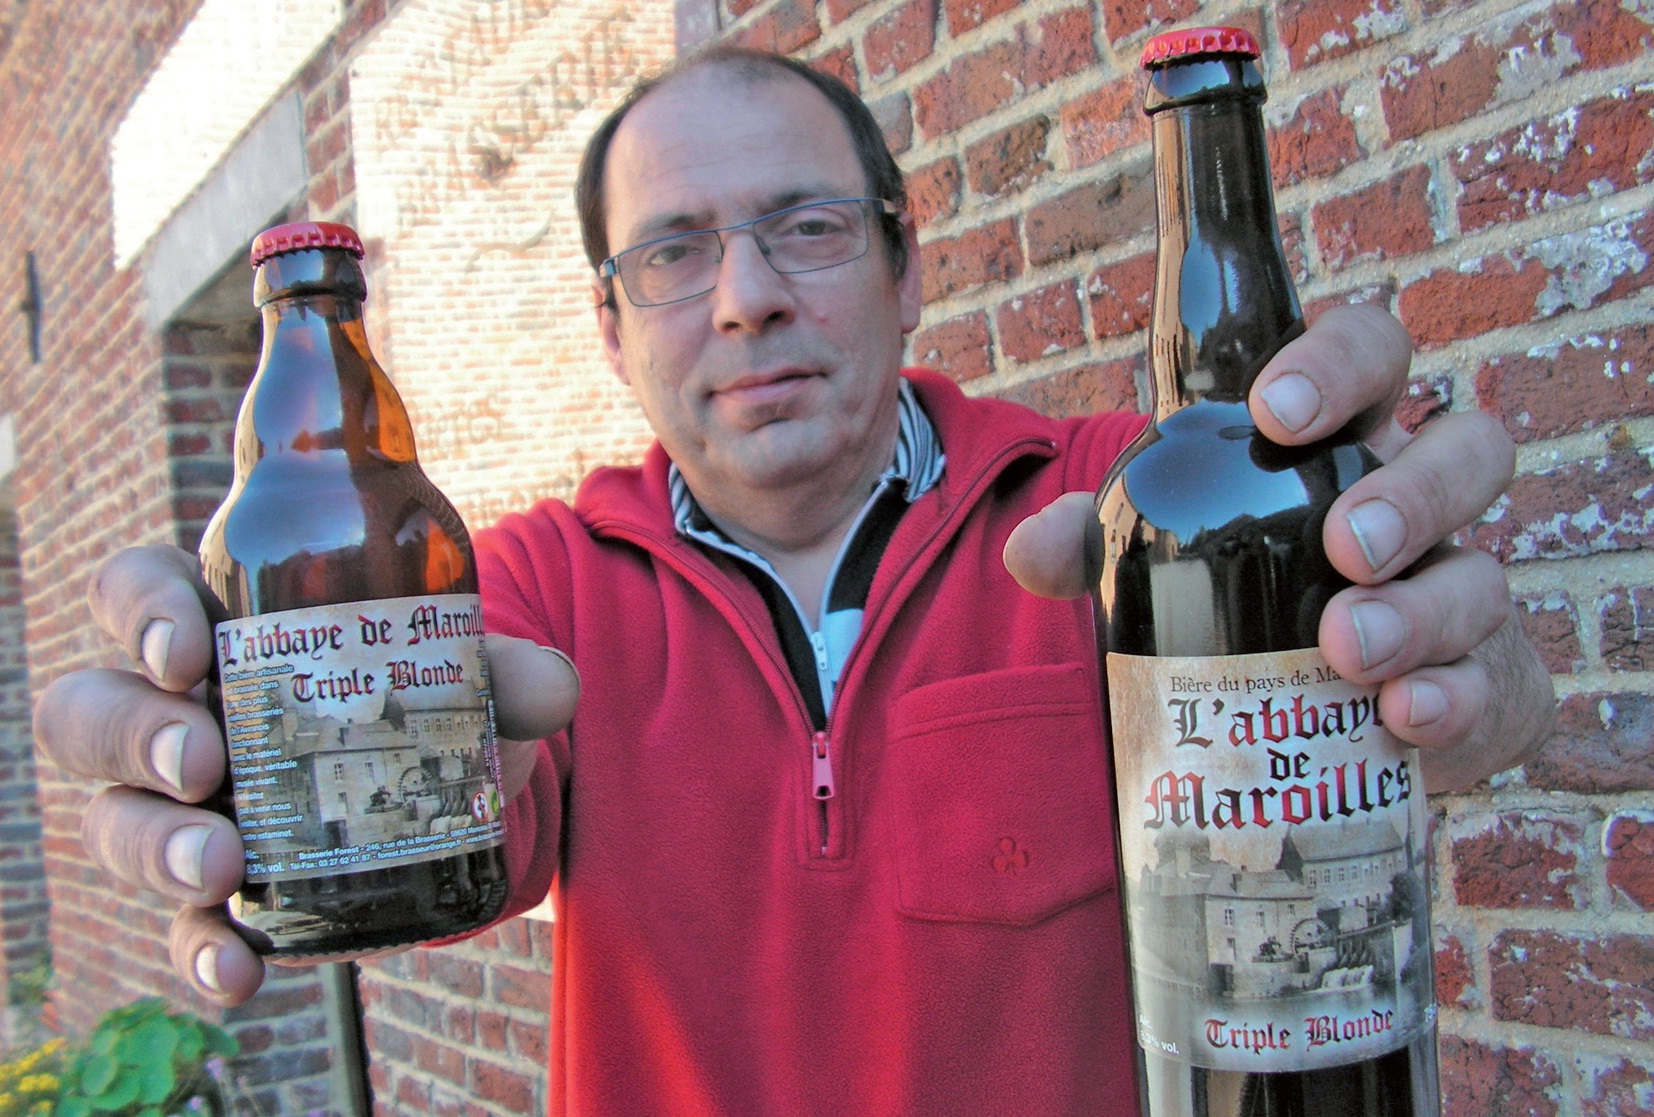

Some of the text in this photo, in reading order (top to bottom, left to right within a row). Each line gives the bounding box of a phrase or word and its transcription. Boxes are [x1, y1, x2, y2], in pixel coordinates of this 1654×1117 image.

[218, 603, 485, 668] L'abbaye de Maroill
[256, 665, 294, 677] artisanale
[260, 681, 280, 691] dans
[291, 658, 464, 704] Triple Blonde
[1170, 665, 1345, 695] Bière du pays de Ma
[252, 696, 269, 707] plus
[247, 707, 285, 719] brasseries
[253, 747, 282, 759] matériel
[264, 760, 298, 772] véritable
[1266, 747, 1312, 781] de
[1143, 758, 1412, 831] Maroilles
[272, 802, 292, 811] nous
[259, 818, 266, 826] et
[267, 814, 304, 826] découvrir
[257, 829, 294, 840] estaminet.
[298, 849, 334, 861] Brasserie
[334, 846, 360, 856] Forest
[383, 840, 396, 849] rue
[396, 839, 407, 847] de
[407, 837, 415, 845] la
[415, 832, 446, 844] Brasserie
[267, 861, 286, 873] vol.
[318, 859, 329, 868] 03
[329, 857, 339, 867] 27
[339, 856, 350, 865] 62
[350, 855, 360, 864] 41
[1205, 1008, 1394, 1055] Triple Blonde
[1161, 1040, 1180, 1055] vol.
